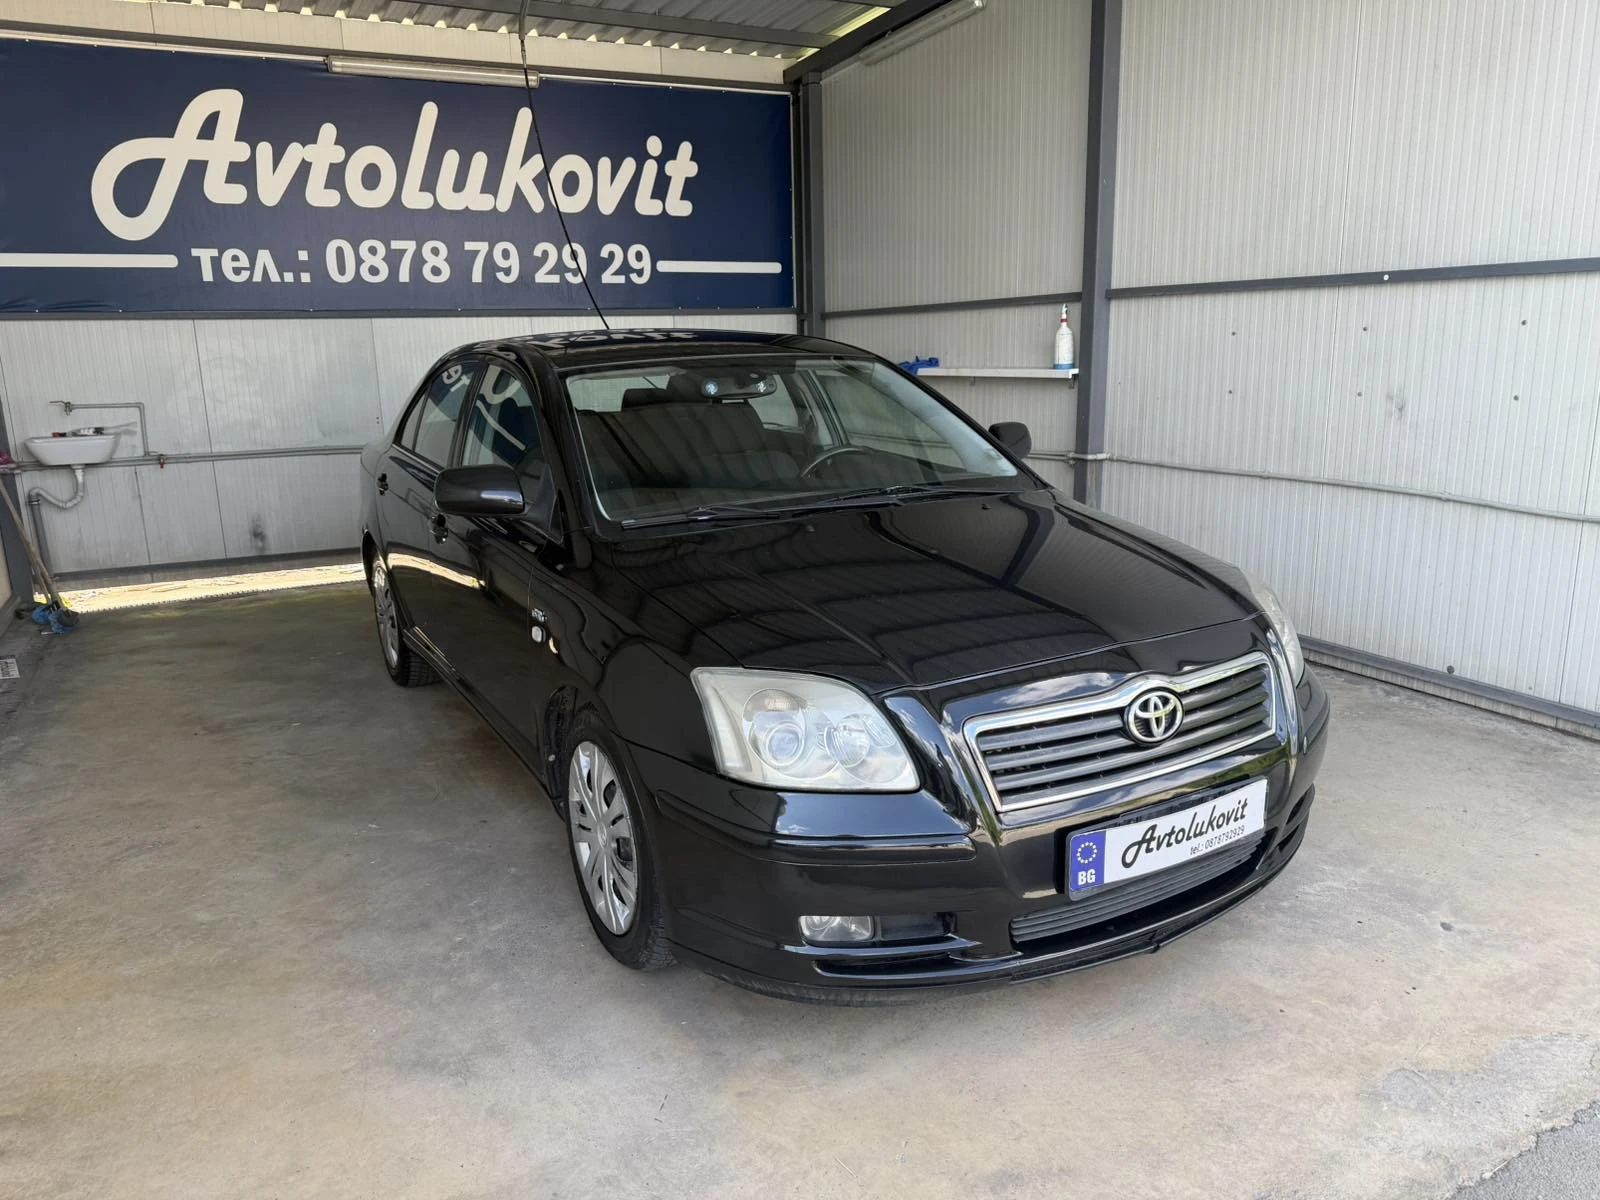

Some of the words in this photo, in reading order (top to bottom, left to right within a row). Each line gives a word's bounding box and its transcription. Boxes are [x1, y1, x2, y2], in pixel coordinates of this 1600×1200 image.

[91, 89, 699, 241] Avtolukovit
[191, 247, 311, 286] тел.:
[326, 238, 451, 284] 0878
[463, 240, 520, 284] 79
[532, 242, 588, 285] 29
[599, 243, 652, 286] 29
[1121, 798, 1248, 869] Avtolukovit
[1077, 868, 1096, 886] BG
